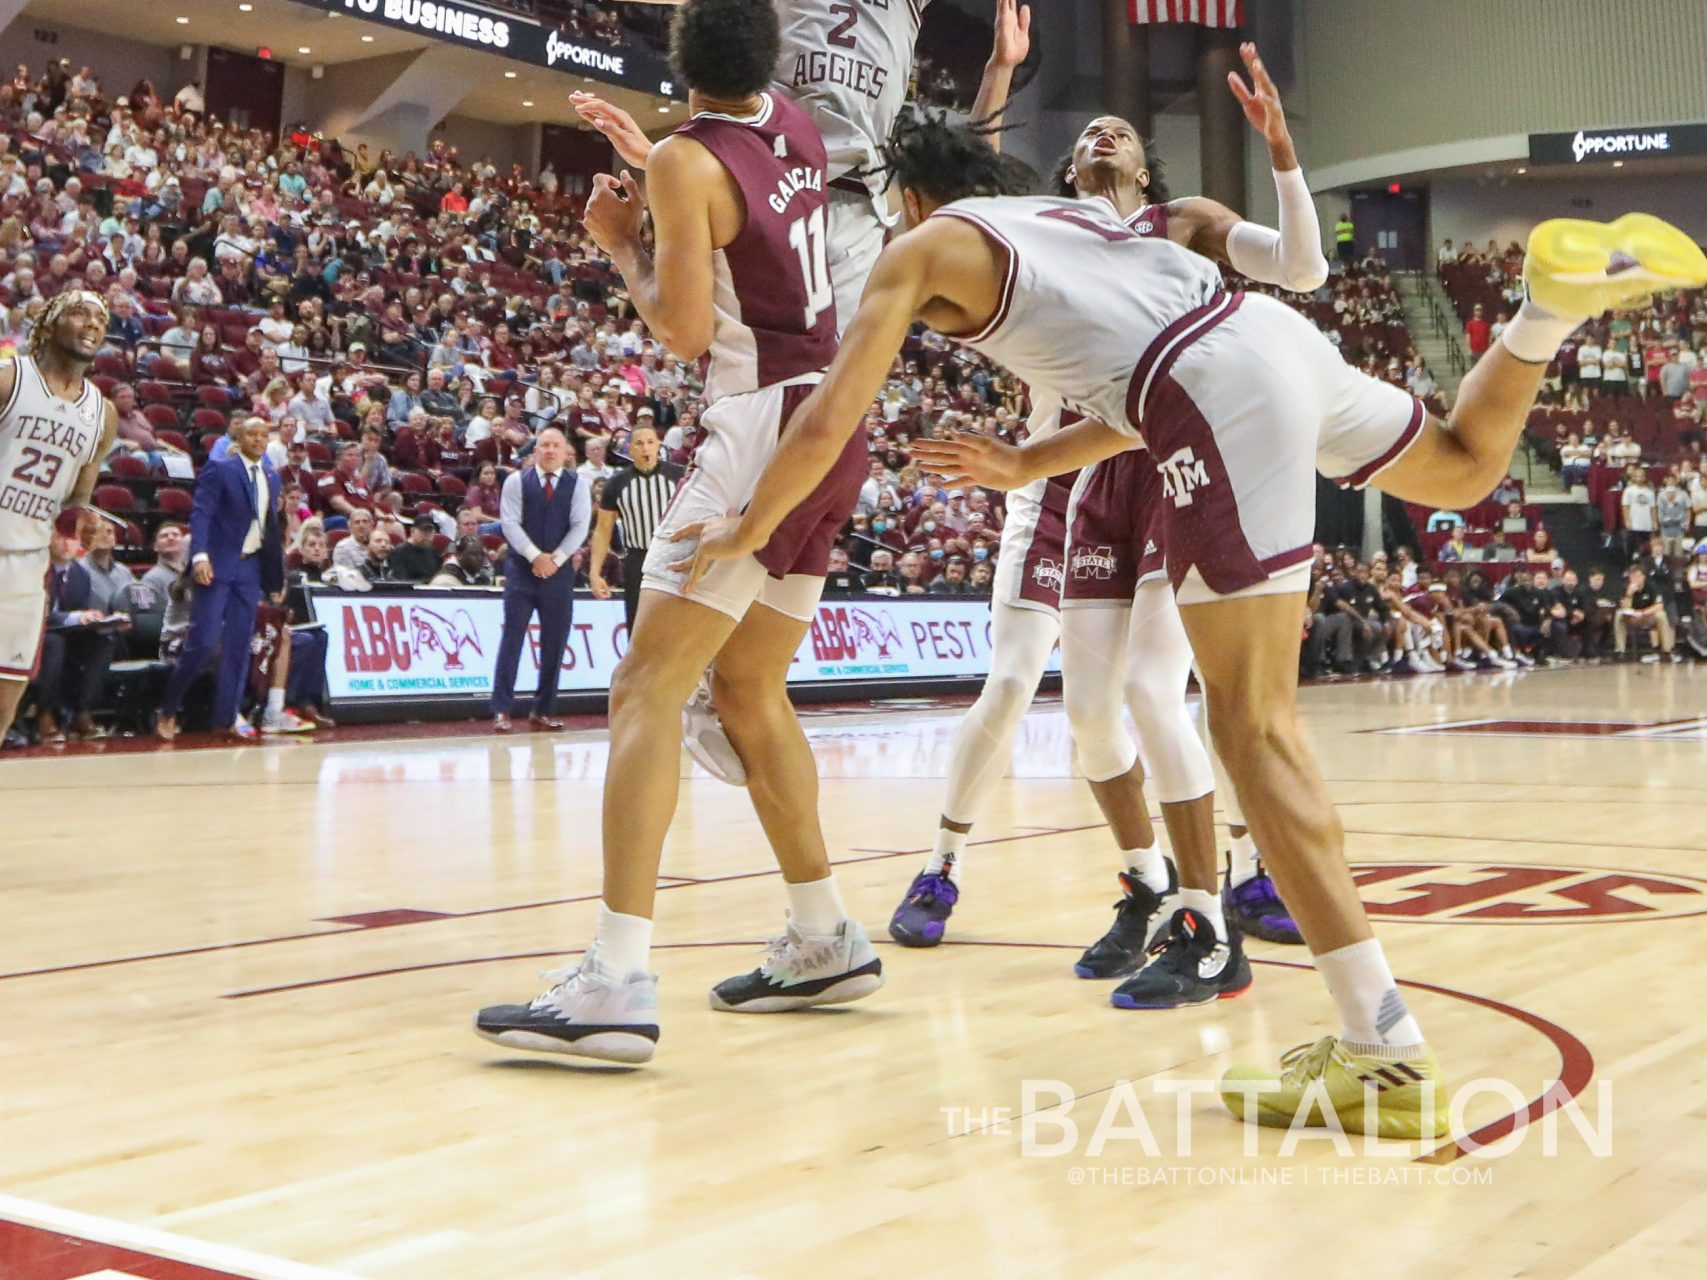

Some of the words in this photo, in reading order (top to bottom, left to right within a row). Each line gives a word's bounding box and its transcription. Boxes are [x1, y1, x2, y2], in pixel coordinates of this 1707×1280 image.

[827, 3, 858, 49] 2
[793, 51, 888, 100] AGGIES
[1572, 131, 1670, 162] OPPORTUNE
[788, 205, 833, 330] 11
[15, 416, 87, 458] TEXAS
[12, 446, 63, 489] 23
[342, 605, 412, 672] ABC
[811, 607, 857, 661] ABC
[911, 621, 976, 660] PEST
[349, 678, 374, 691] HOME
[378, 677, 385, 690] &
[387, 677, 446, 690] COMMERCIAL
[449, 676, 489, 689] SERVICES
